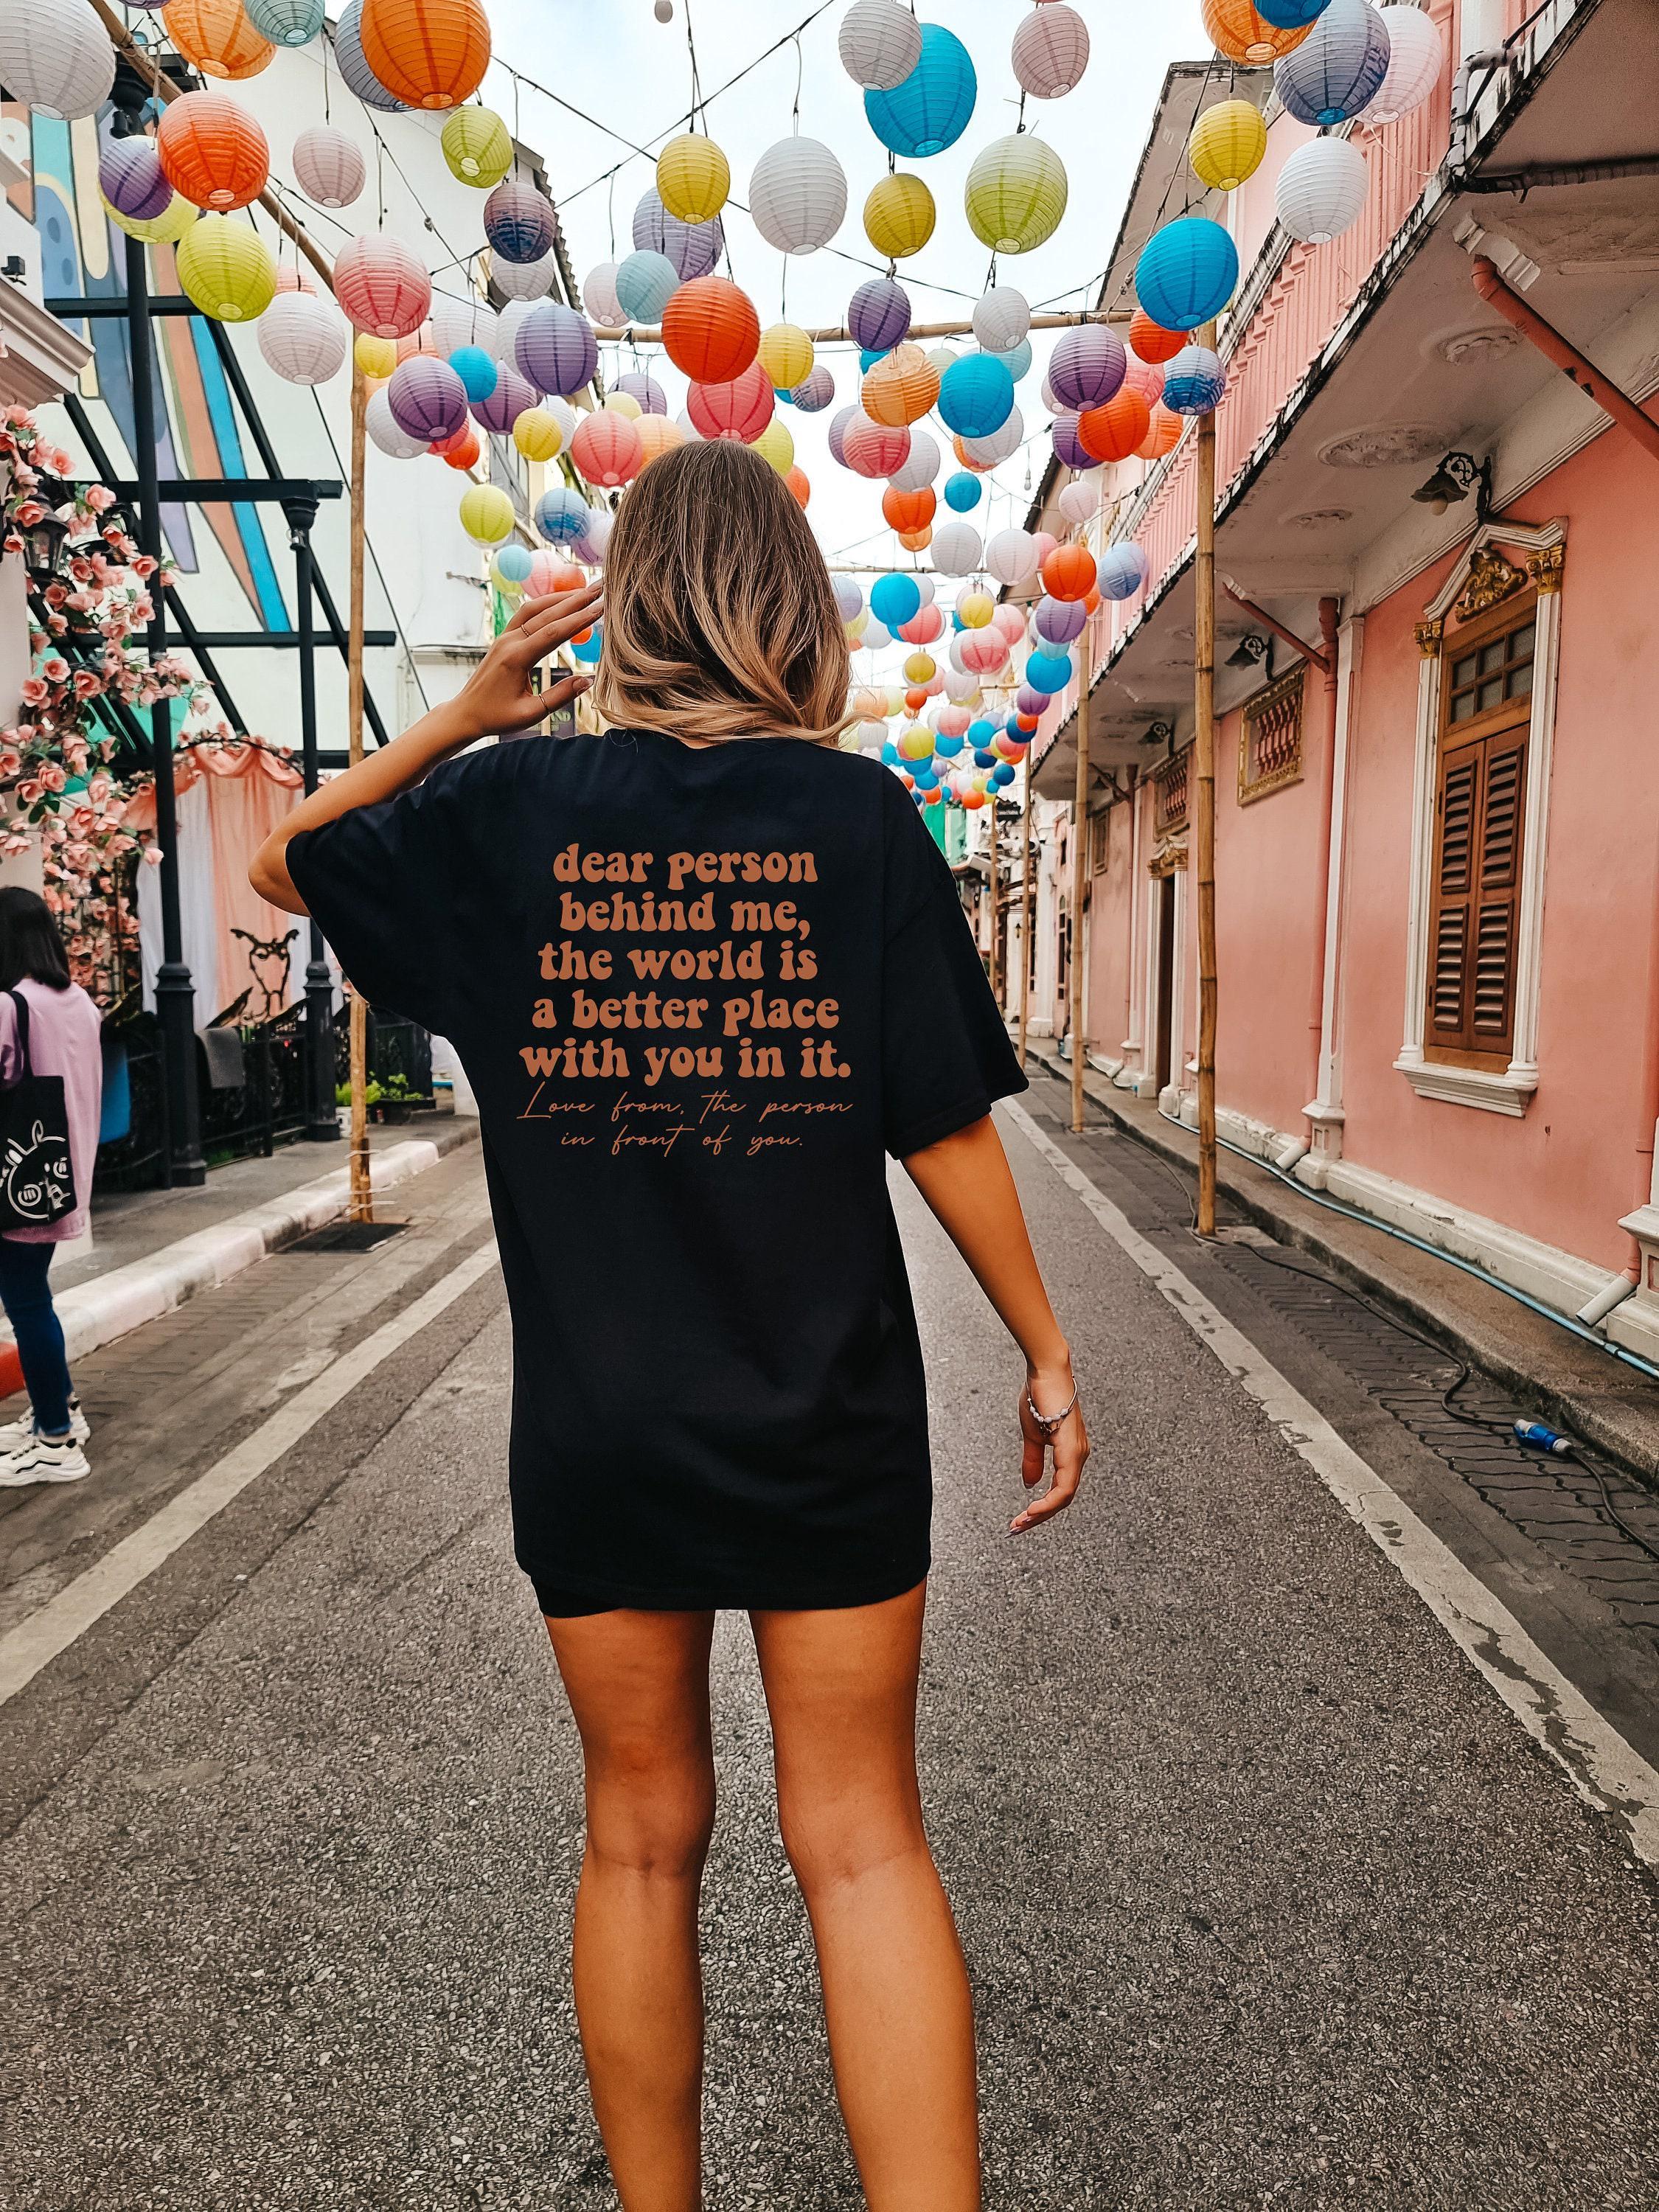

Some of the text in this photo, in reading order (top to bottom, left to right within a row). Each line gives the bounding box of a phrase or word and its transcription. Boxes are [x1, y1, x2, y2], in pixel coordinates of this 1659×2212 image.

[553, 843, 818, 891] dear person
[559, 891, 810, 941] behind me,
[538, 939, 818, 981] the world is
[532, 989, 840, 1037] a better place
[518, 1037, 852, 1087] with you in it.
[516, 1080, 596, 1120] Love
[758, 1102, 854, 1123] person
[560, 1124, 803, 1158] in front of you.
